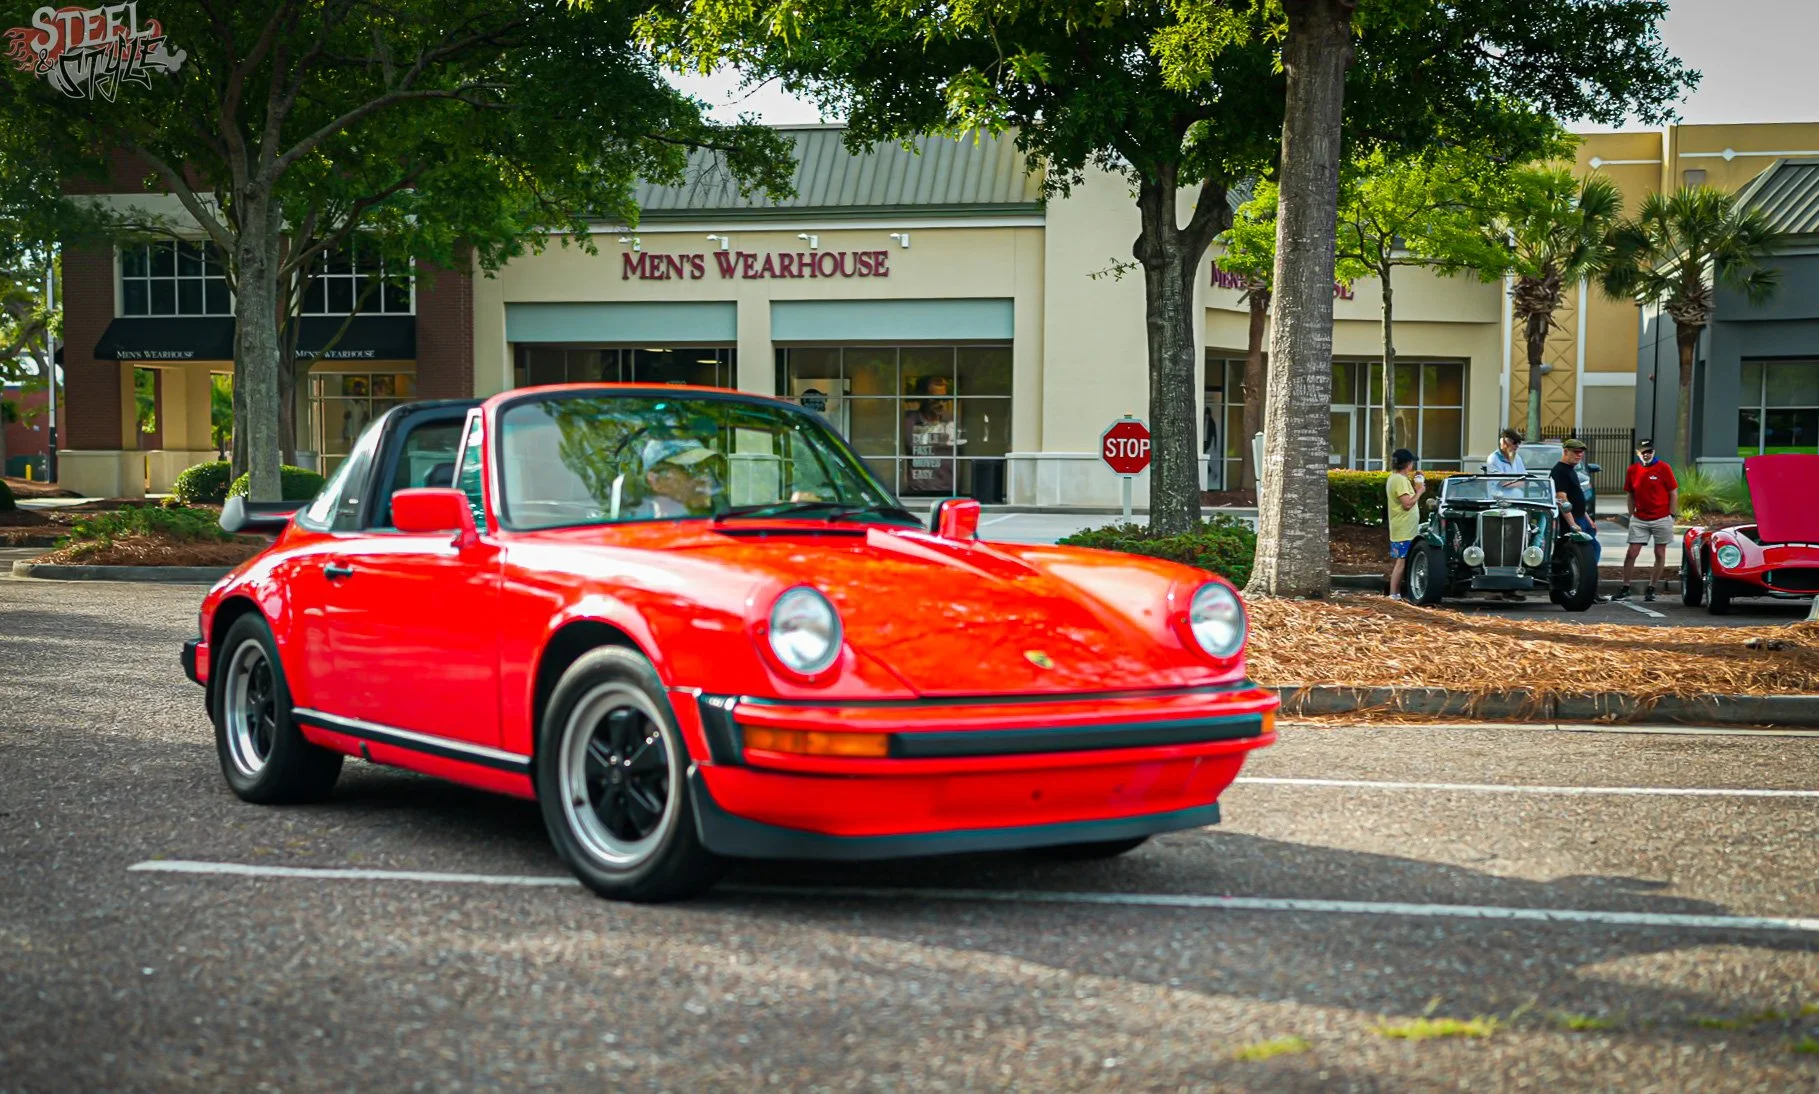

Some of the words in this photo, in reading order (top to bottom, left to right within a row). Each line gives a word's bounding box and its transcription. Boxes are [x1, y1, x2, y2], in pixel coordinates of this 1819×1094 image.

[622, 252, 705, 280] MEN'S
[713, 250, 889, 279] WEARHOUSE
[117, 350, 141, 359] MEN'S
[143, 350, 194, 359] WEARHOUSE
[1105, 438, 1151, 458] STOP
